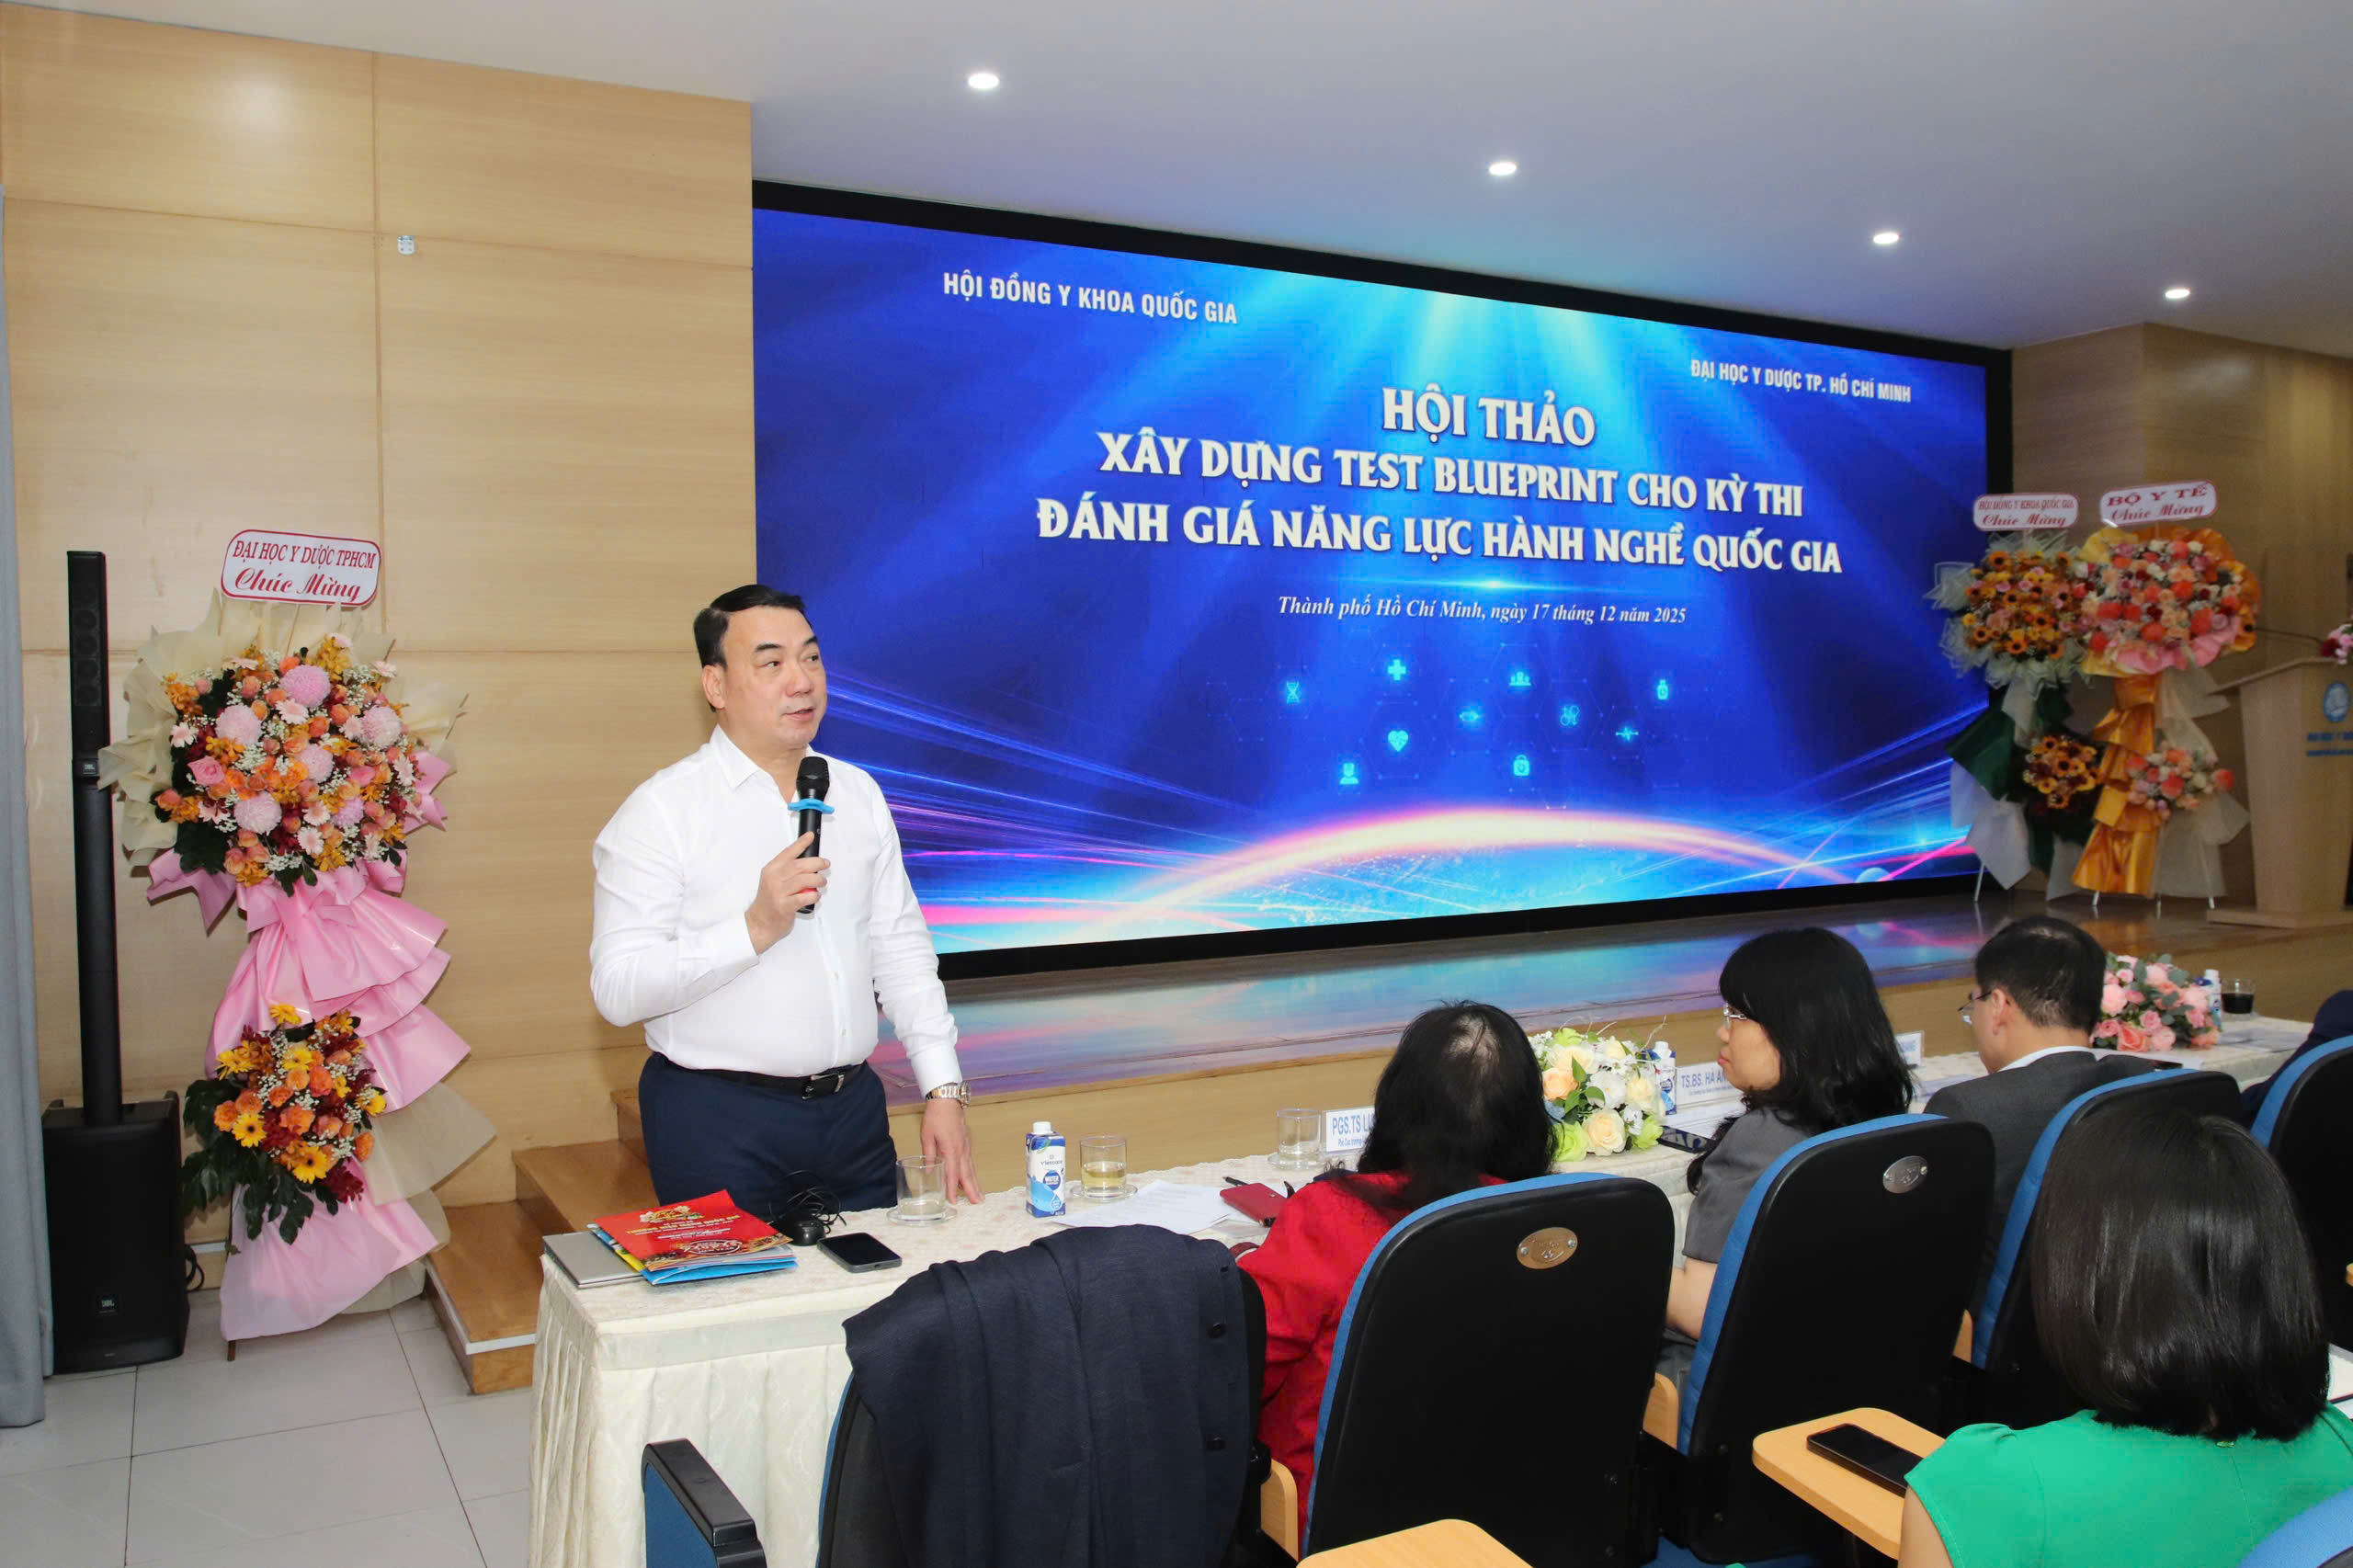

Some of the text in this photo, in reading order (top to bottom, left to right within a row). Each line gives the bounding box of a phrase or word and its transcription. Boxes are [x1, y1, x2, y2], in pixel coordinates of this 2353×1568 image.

[943, 269, 1238, 324] HỘI ĐỒNG Y KHOA QUỐC GIA
[1691, 359, 1714, 382] ĐẠI
[1720, 363, 1748, 385] HỌC
[1752, 367, 1762, 384] Y
[1765, 368, 1802, 392] DƯỢC
[1805, 373, 1826, 392] TP.
[1852, 378, 1875, 398] CHÍ
[1878, 382, 1911, 403] MINH
[1381, 382, 1596, 447] HỘI THẢO
[1096, 426, 1803, 517] XÂY DỰNG TEST BLUEPRINT CHO KỲ THI
[2108, 485, 2208, 506] BỘ Y TẾ
[1037, 491, 1843, 574] ĐÁNH GIÁ NĂNG LỰC HÀNH NGHỀ QUỐC GIA
[233, 540, 377, 569] ĐẠI HỌC Y DƯỢC TPHCM
[234, 567, 361, 603] Chúc Mừng
[1279, 594, 1687, 625] Thành phố Hồ Chí Minh, ngày 17 tháng 12 năm 2025
[1332, 1114, 1361, 1136] PGS.TS
